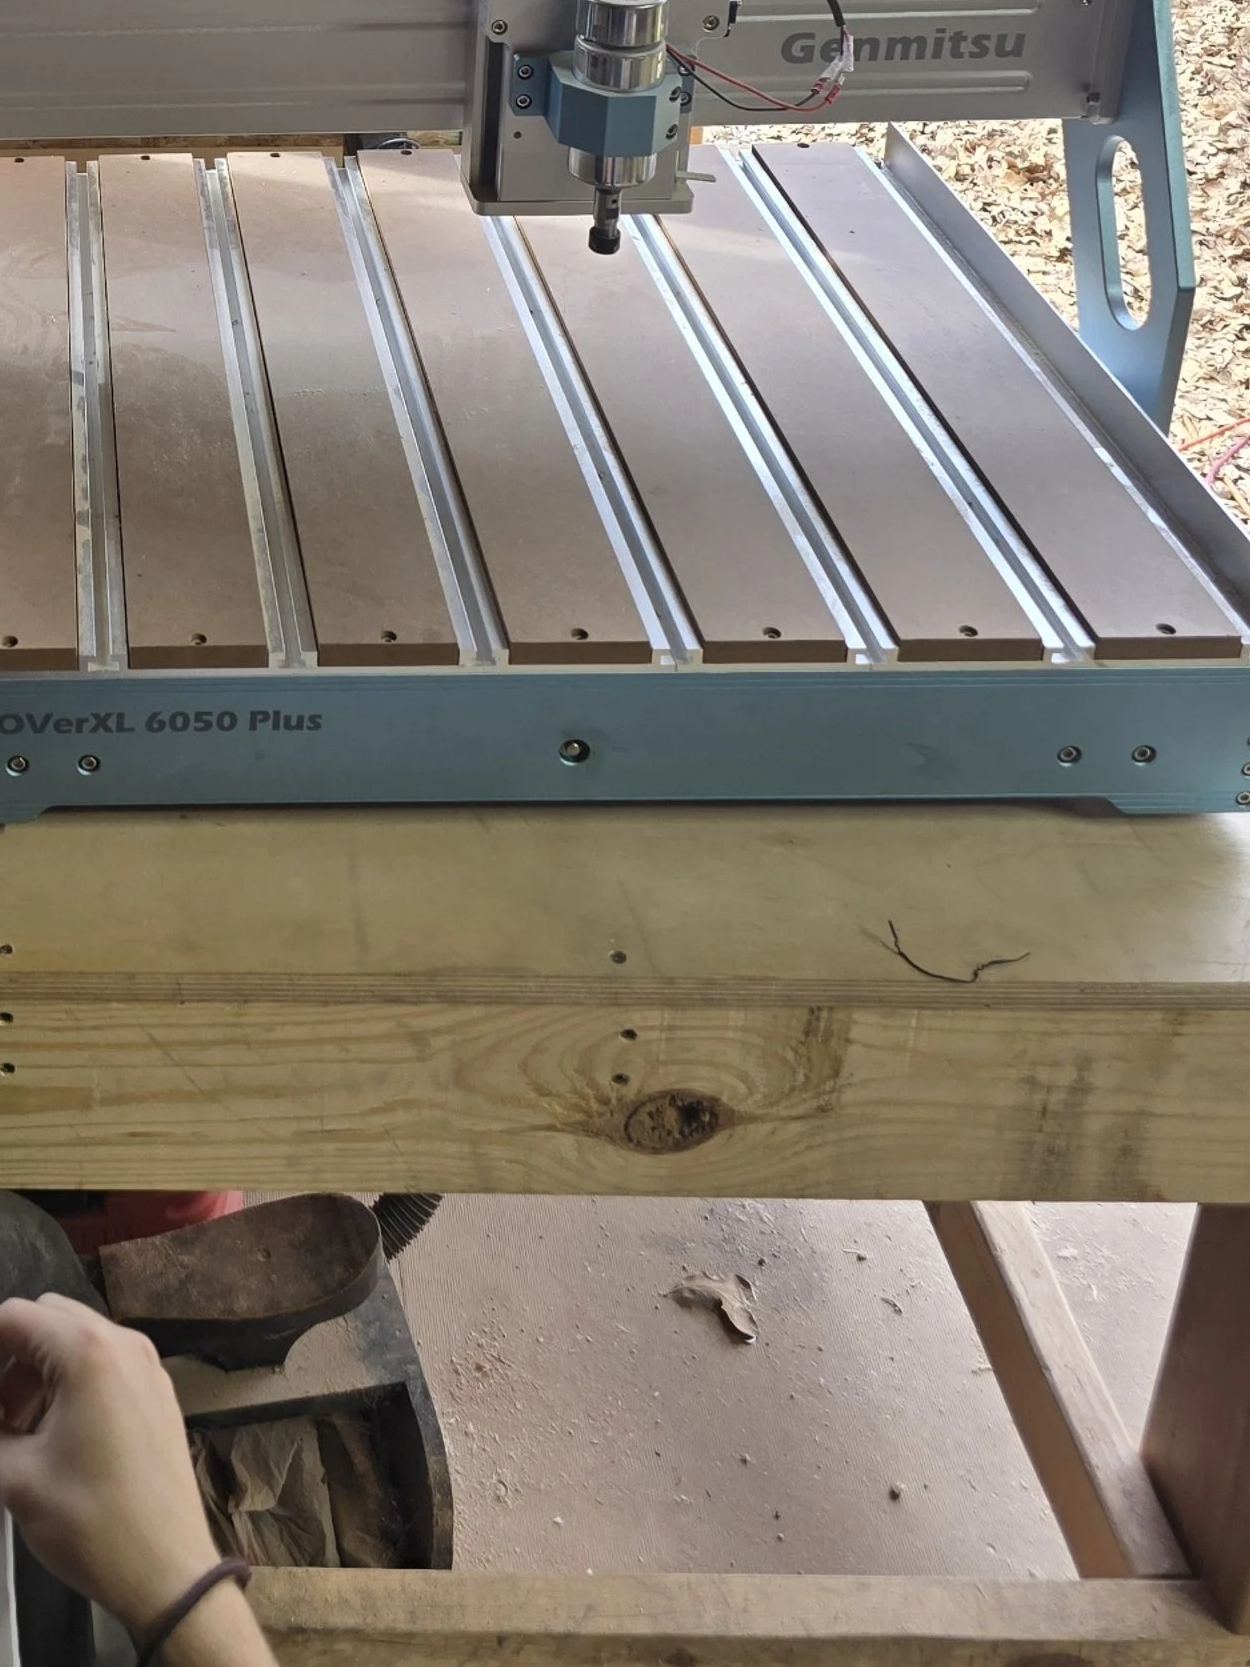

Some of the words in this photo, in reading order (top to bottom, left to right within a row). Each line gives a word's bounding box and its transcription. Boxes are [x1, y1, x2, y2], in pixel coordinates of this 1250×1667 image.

[780, 27, 1027, 64] Genmitsu
[144, 709, 237, 734] 6050
[248, 709, 324, 732] Plus
